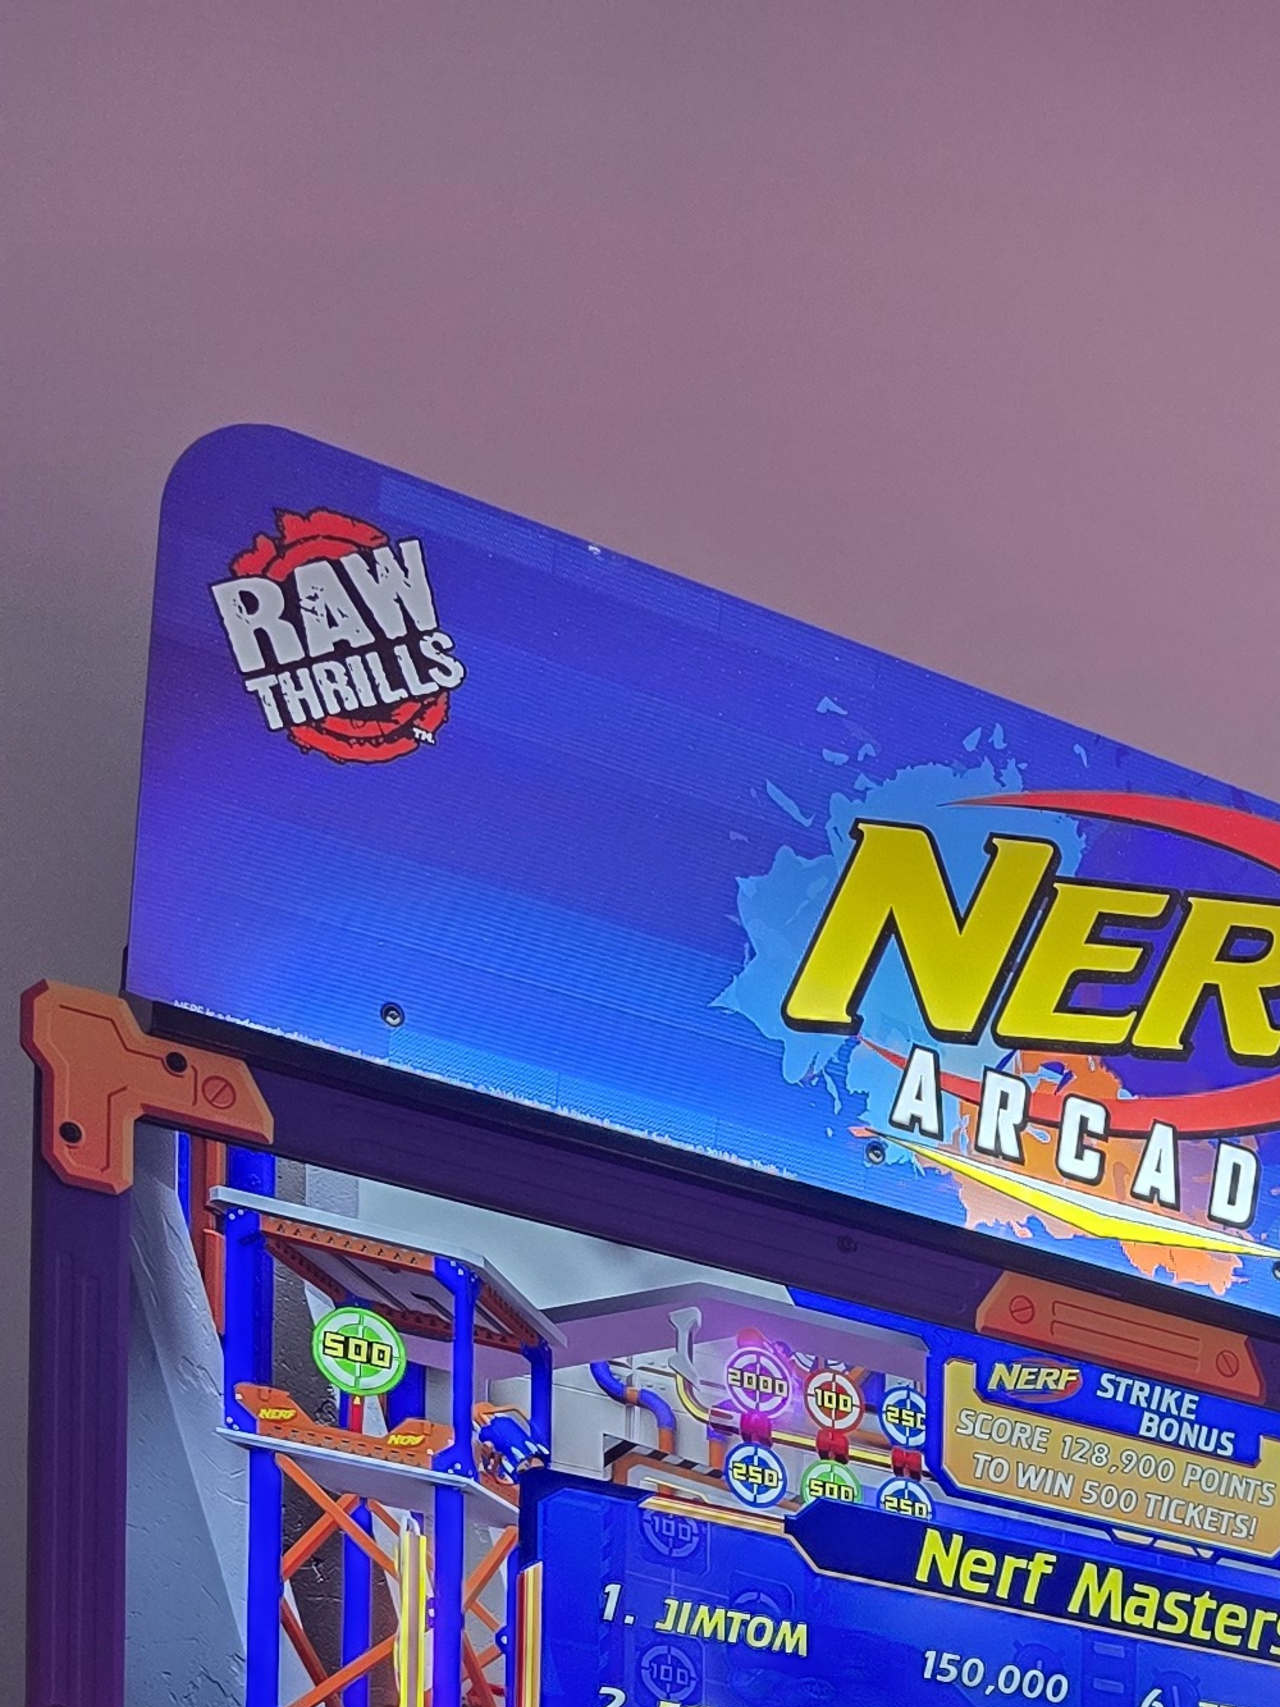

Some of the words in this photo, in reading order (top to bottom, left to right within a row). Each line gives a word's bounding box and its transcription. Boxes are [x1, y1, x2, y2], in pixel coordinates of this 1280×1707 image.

[211, 539, 441, 674] RAW
[246, 632, 464, 729] THRILLS
[322, 1330, 392, 1369] 500
[726, 1371, 788, 1399] 2000
[813, 1392, 853, 1413] 100
[987, 1363, 1080, 1391] NERF
[1096, 1372, 1199, 1420] STRIKE
[956, 1408, 1050, 1454] SCORE
[1061, 1434, 1175, 1482] 128,900
[1183, 1462, 1276, 1507] POINTS
[1139, 1411, 1236, 1457] BONUS
[732, 1462, 779, 1488] 250
[808, 1477, 854, 1501] 500
[973, 1453, 1010, 1482] TO
[1016, 1461, 1074, 1499] WIN
[1081, 1482, 1138, 1513] 500
[1145, 1493, 1257, 1540] TICKETS!
[915, 1527, 1058, 1605] Nerf
[601, 1584, 635, 1625] 1.
[655, 1597, 809, 1658] JIMTOM
[922, 1649, 1070, 1704] 150,000
